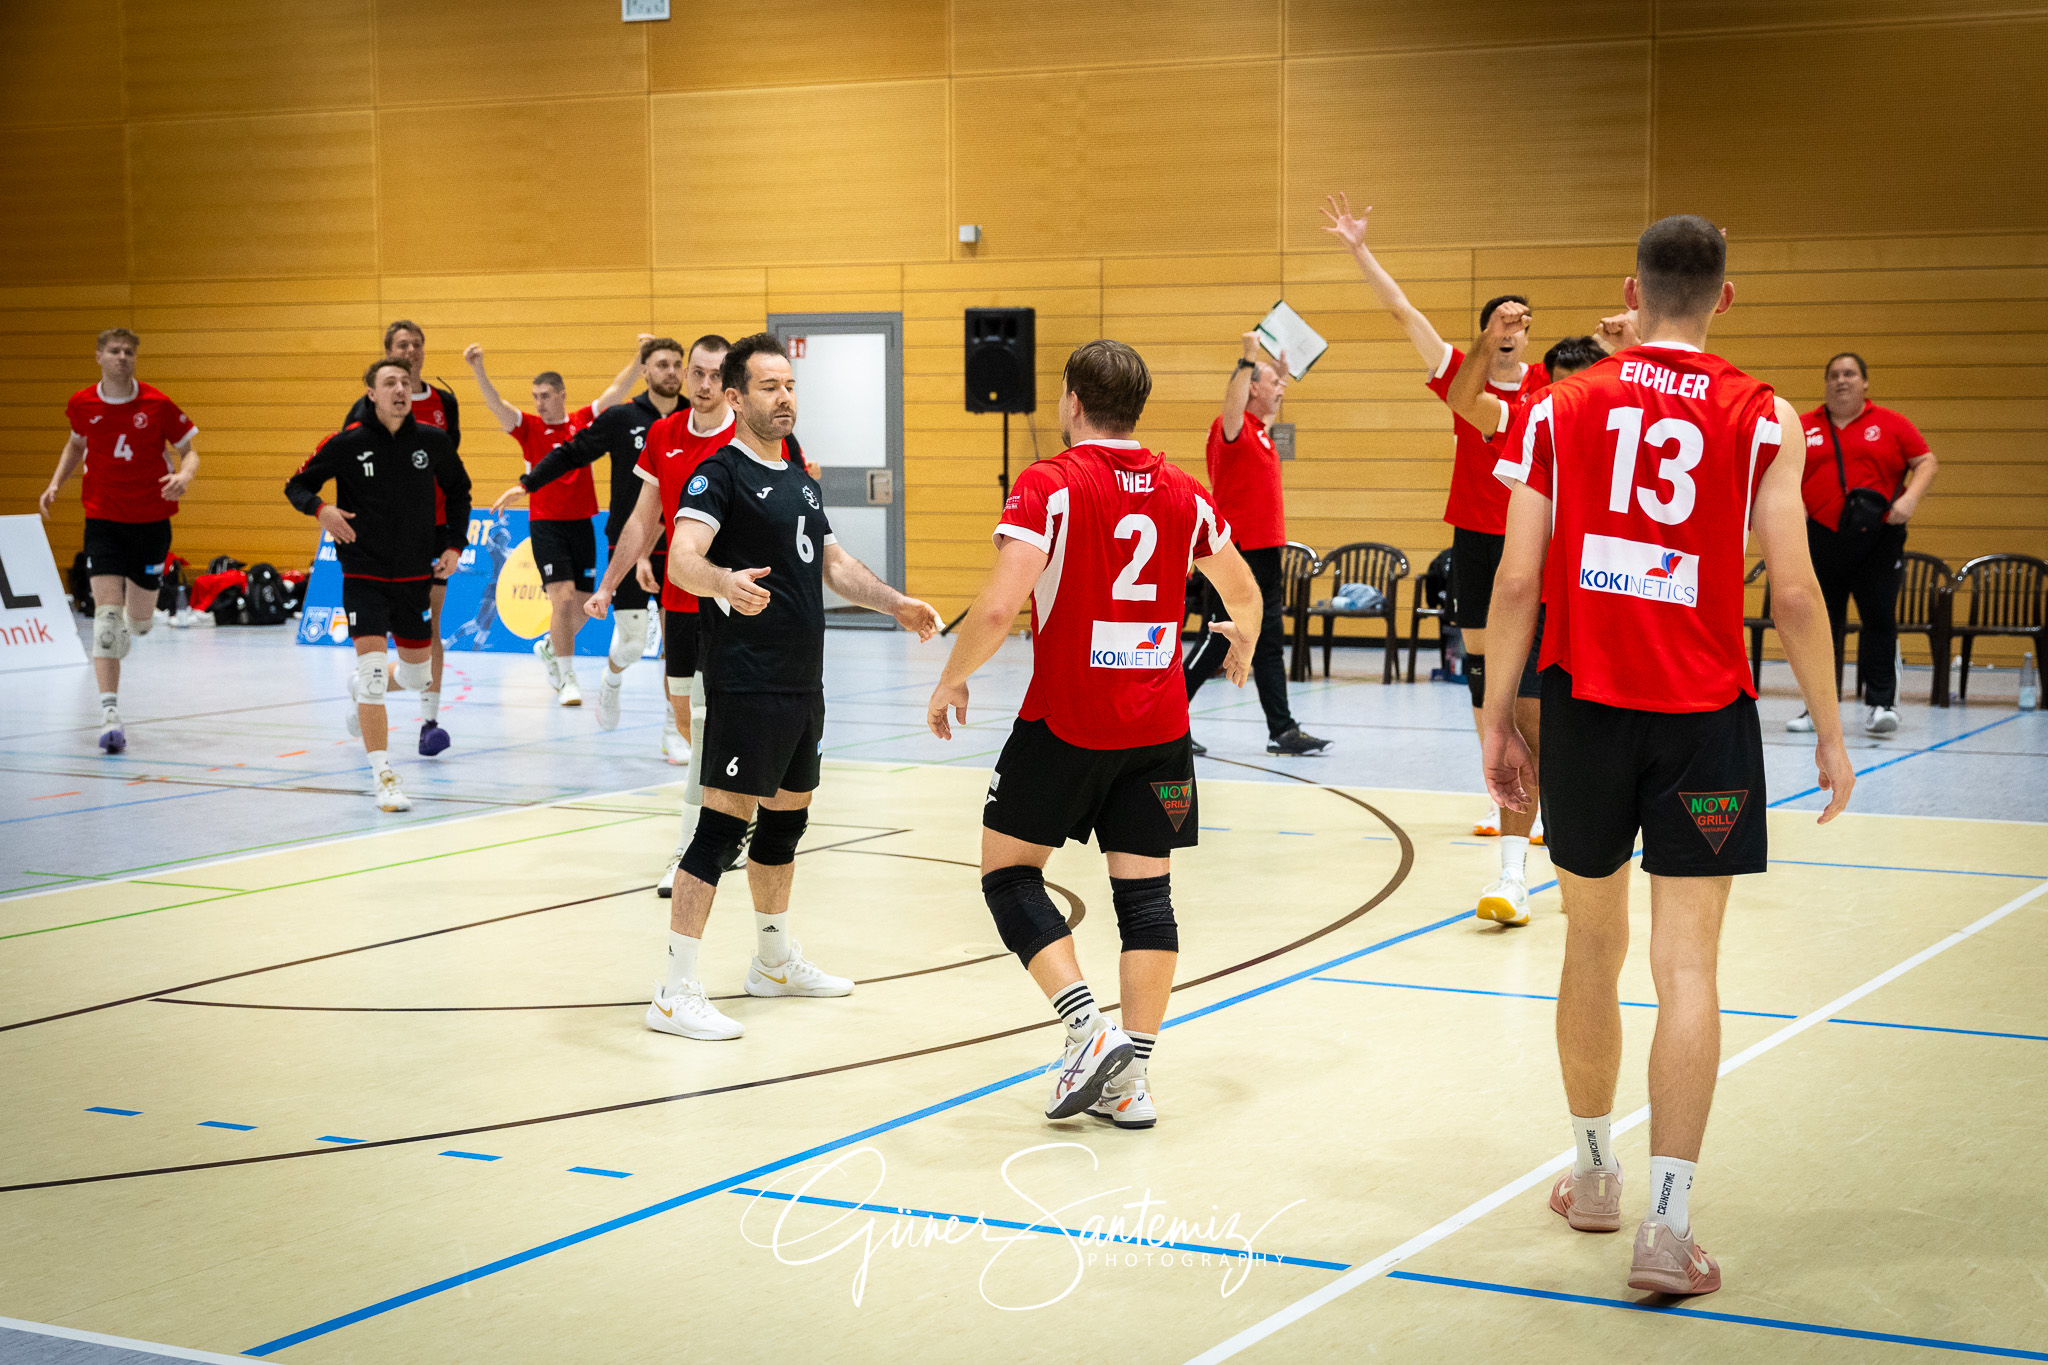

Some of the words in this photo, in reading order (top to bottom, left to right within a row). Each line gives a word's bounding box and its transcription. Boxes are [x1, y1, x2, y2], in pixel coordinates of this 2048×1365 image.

[1619, 361, 1710, 400] EICHLER
[113, 433, 134, 461] 4
[634, 435, 644, 449] 8
[362, 461, 375, 477] 11
[1606, 406, 1704, 525] 13
[796, 515, 815, 563] 6
[1112, 513, 1158, 601] 2
[1579, 567, 1696, 605] KOKINETICS
[725, 756, 739, 777] 6
[1164, 799, 1190, 809] GRILL
[1691, 796, 1739, 814] NOVA
[1697, 814, 1733, 826] GRILL
[1586, 1129, 1603, 1167] CRUNCHTIME
[1656, 1171, 1676, 1216] CRUNCHTIME
